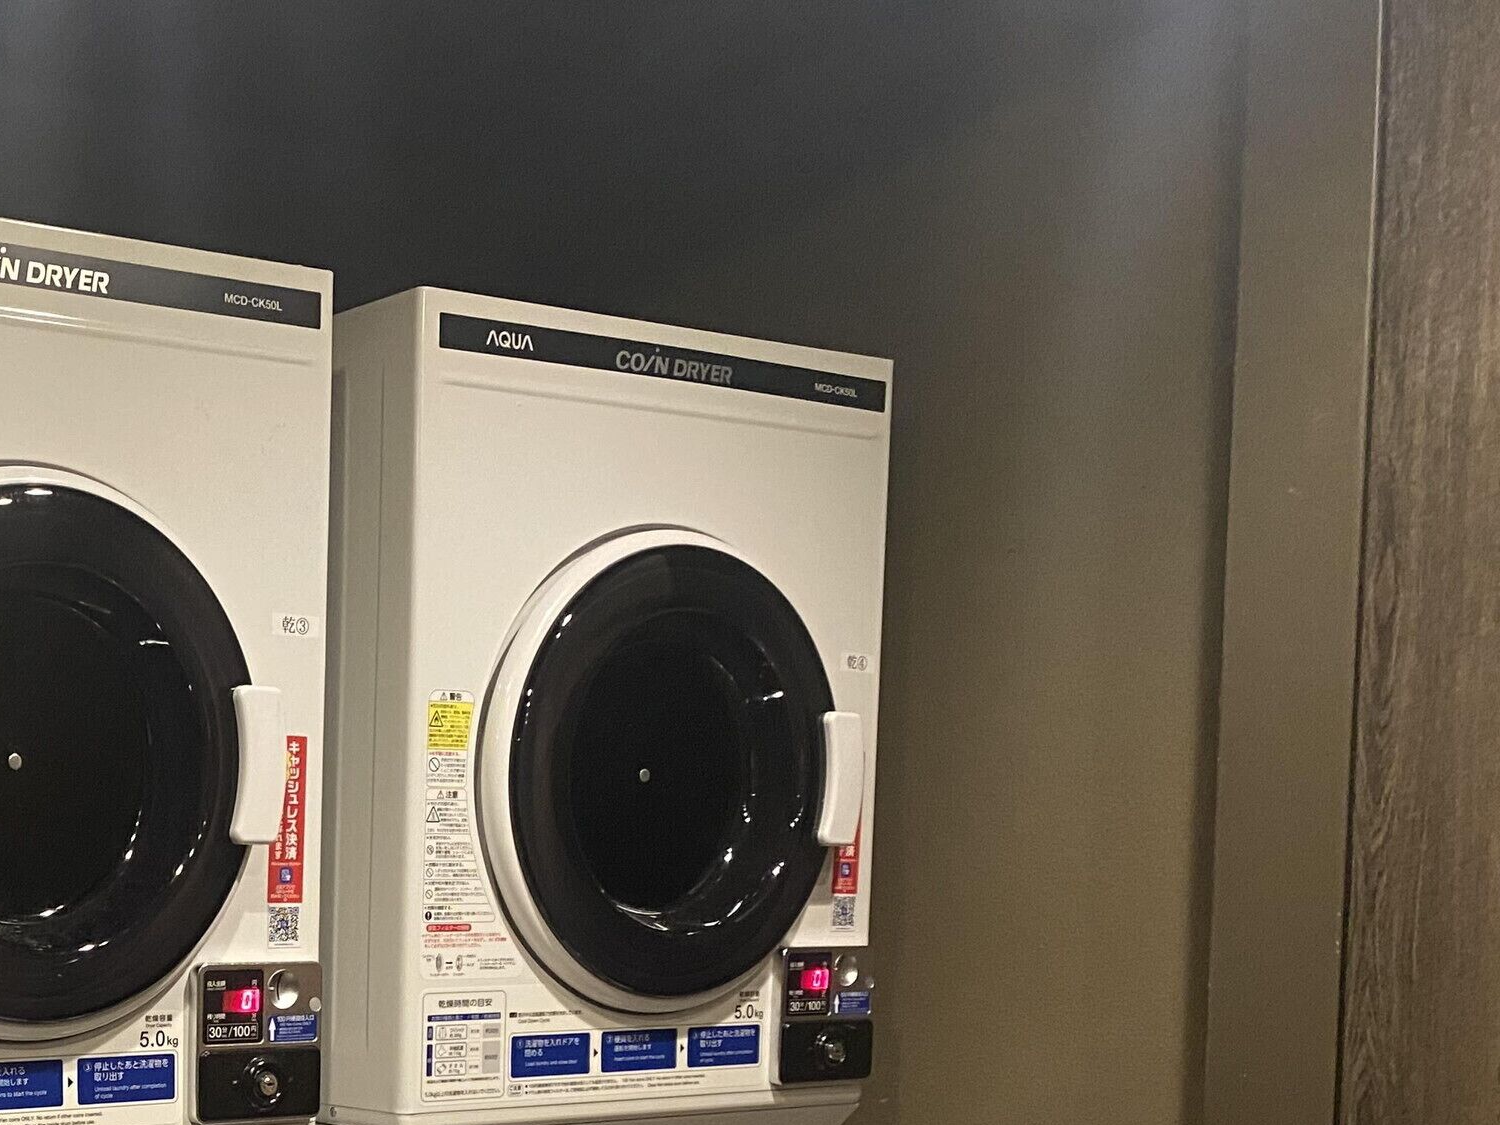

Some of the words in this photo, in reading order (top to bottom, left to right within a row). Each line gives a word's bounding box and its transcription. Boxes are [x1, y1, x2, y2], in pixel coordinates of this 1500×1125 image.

[27, 261, 110, 295] DRYER
[223, 291, 283, 313] MCD-CK50L
[486, 330, 534, 351] AQUA
[615, 347, 669, 376] COIN
[674, 358, 733, 385] DRYER
[286, 741, 301, 860] キャッシュレス決済
[733, 1004, 754, 1019] 5.0
[140, 1030, 165, 1047] 5.0
[167, 1036, 178, 1047] kg
[94, 1058, 169, 1072] 停止したあと洗濯物を
[94, 1072, 125, 1082] 取り出す
